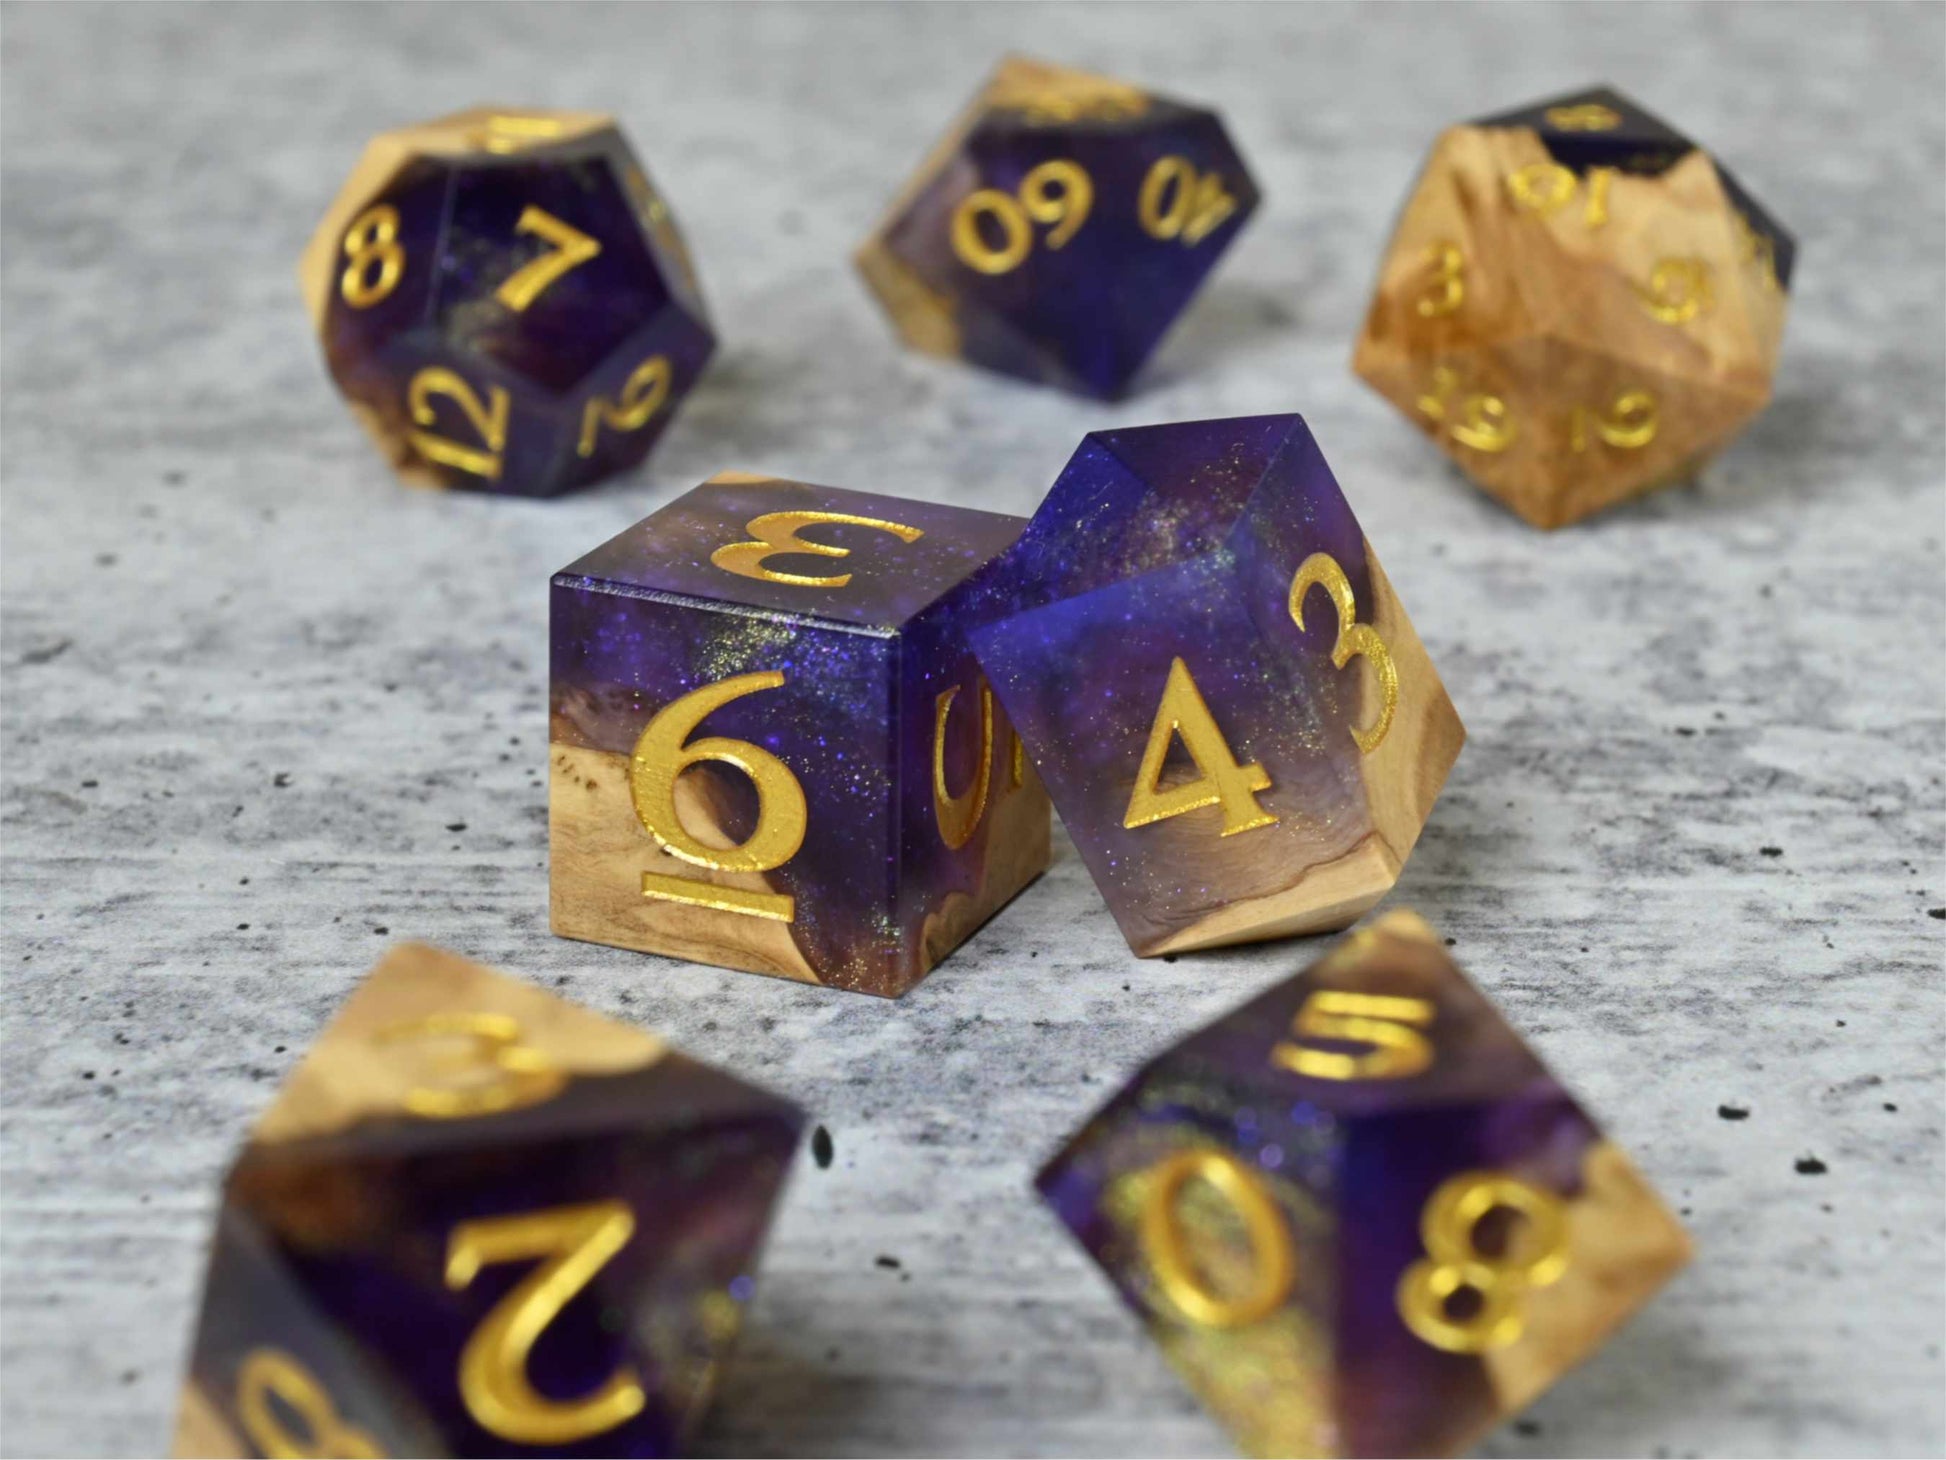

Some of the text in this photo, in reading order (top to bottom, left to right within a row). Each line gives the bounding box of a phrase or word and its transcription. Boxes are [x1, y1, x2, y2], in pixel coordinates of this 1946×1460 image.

[341, 205, 404, 308] 8
[498, 205, 601, 311] 7
[407, 366, 511, 480] 12
[710, 510, 925, 588] 3
[1288, 552, 1399, 755] 3
[630, 670, 808, 874] 6
[1122, 655, 1280, 838] 4
[1272, 988, 1435, 1080] 5
[445, 1200, 647, 1440] 2
[1140, 1150, 1293, 1327] 0
[1396, 1170, 1573, 1355] 8
